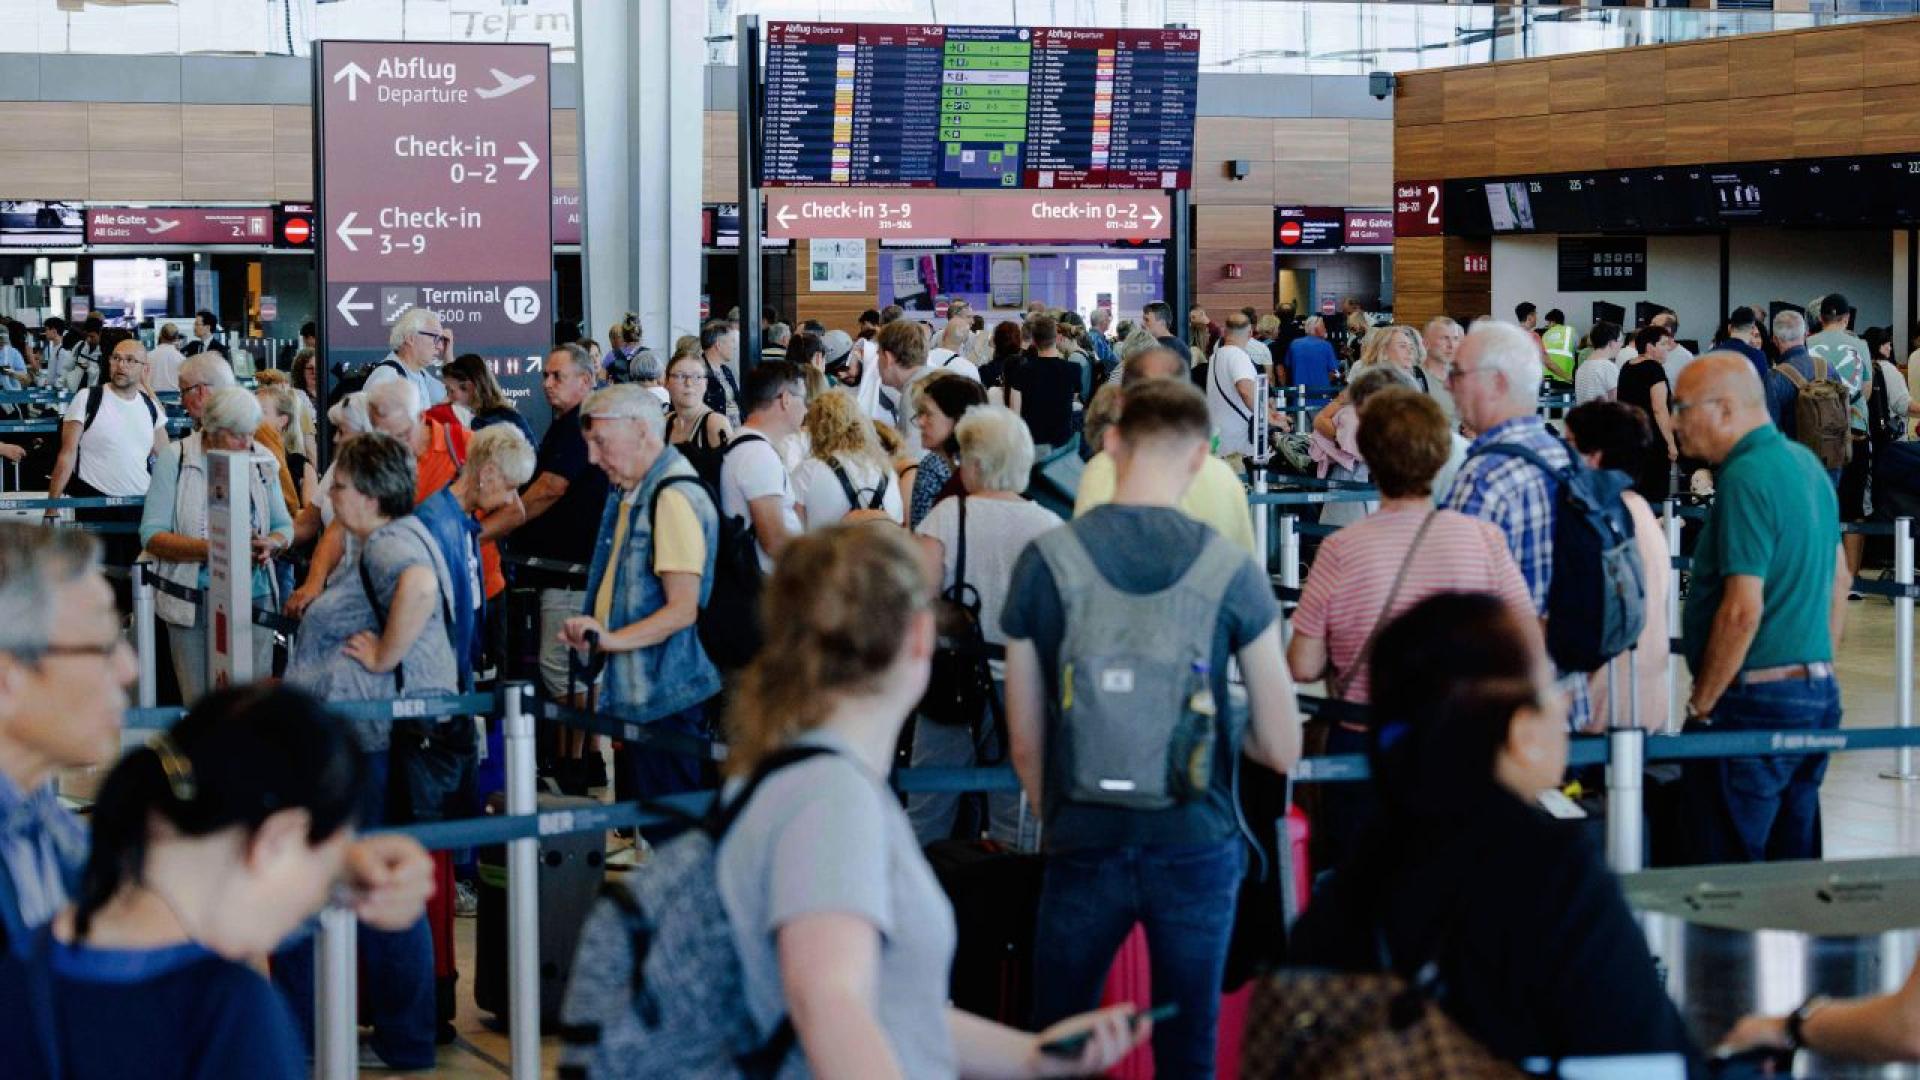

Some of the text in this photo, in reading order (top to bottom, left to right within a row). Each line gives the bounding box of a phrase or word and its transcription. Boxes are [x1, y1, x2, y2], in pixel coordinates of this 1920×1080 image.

[785, 24, 811, 35] Abflug
[1048, 29, 1072, 40] Abflug
[376, 57, 456, 85] Abflug
[377, 85, 468, 107] Departure
[395, 134, 497, 157] Check-in
[801, 200, 875, 219] Check-in
[1031, 201, 1102, 219] Check-in
[1427, 185, 1440, 225] 2
[94, 215, 147, 226] Alle Gates
[379, 206, 482, 229] Check-in
[1350, 218, 1392, 229] Alle Gates
[94, 228, 130, 237] All Gates
[1361, 230, 1379, 239] Gates
[421, 286, 535, 314] Terminal T2
[438, 308, 482, 322] 600 m
[392, 699, 426, 718] BER
